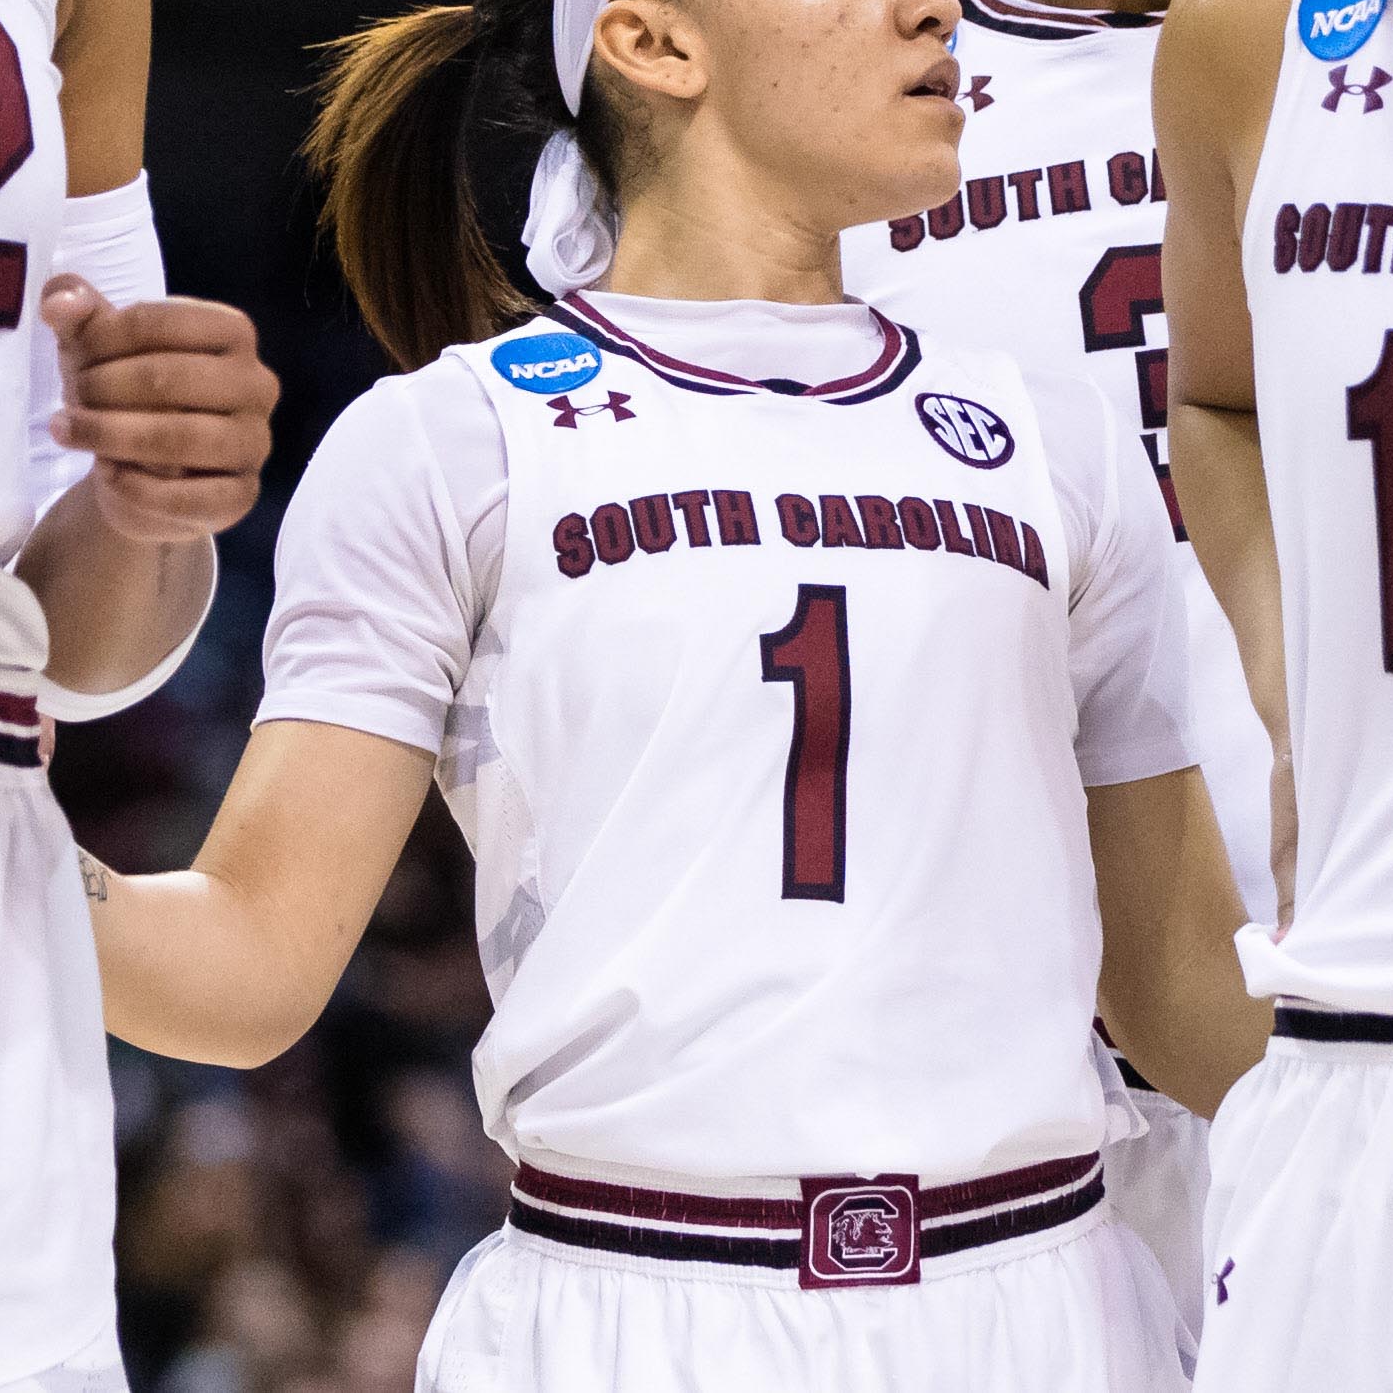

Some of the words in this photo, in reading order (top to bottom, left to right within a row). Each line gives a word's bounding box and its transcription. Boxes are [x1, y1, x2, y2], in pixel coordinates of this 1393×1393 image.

[509, 351, 599, 380] NCAA
[919, 395, 1010, 463] SEC
[552, 490, 761, 579] SOUTH
[774, 493, 1050, 591] CAROLINA
[759, 583, 852, 904] 1
